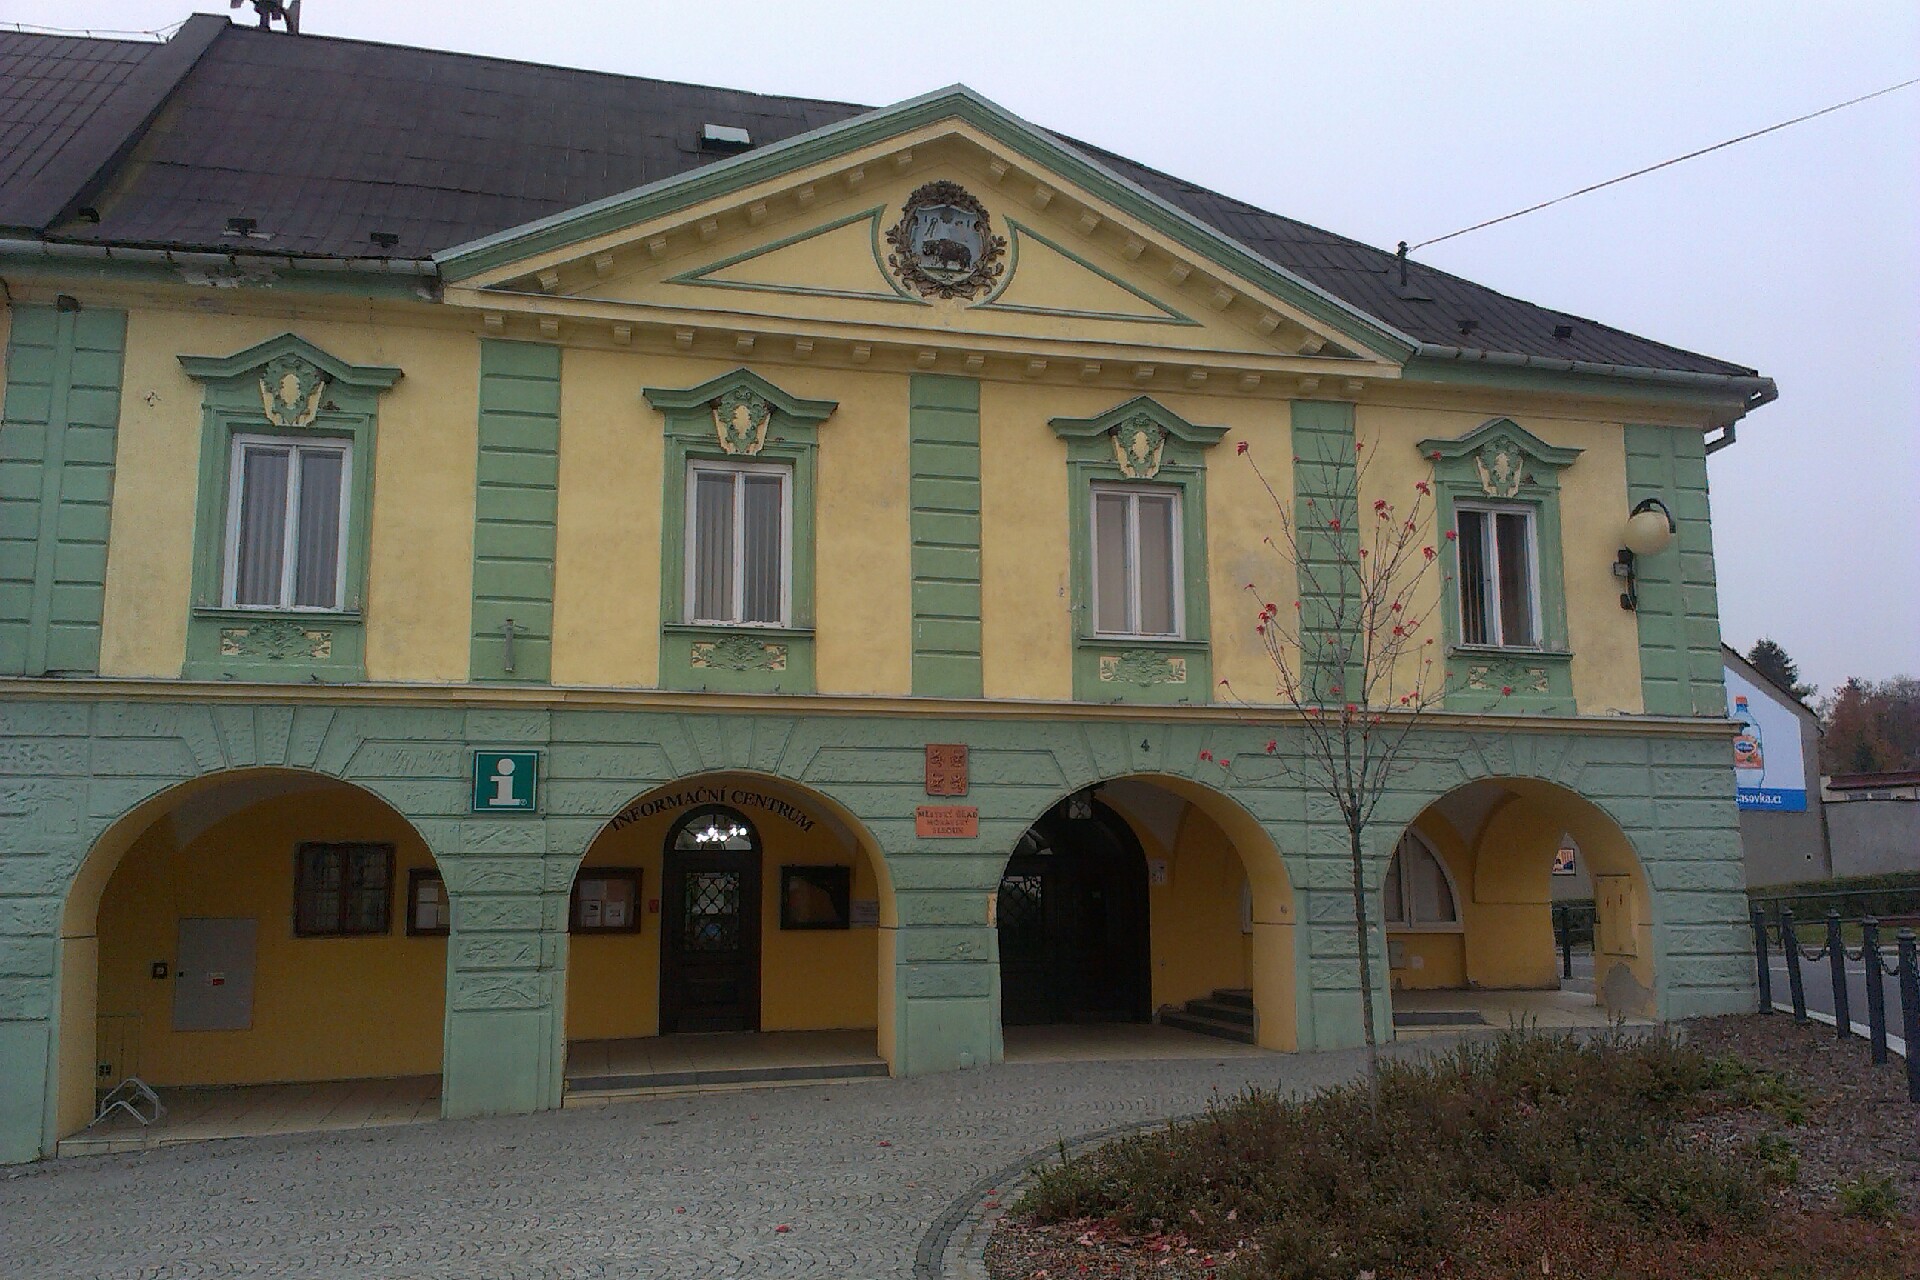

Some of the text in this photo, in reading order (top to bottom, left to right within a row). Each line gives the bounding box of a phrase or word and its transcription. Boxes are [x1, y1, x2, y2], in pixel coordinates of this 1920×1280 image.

[1140, 738, 1150, 752] 4
[610, 786, 816, 833] INFORMAČNÍ CENTRUM
